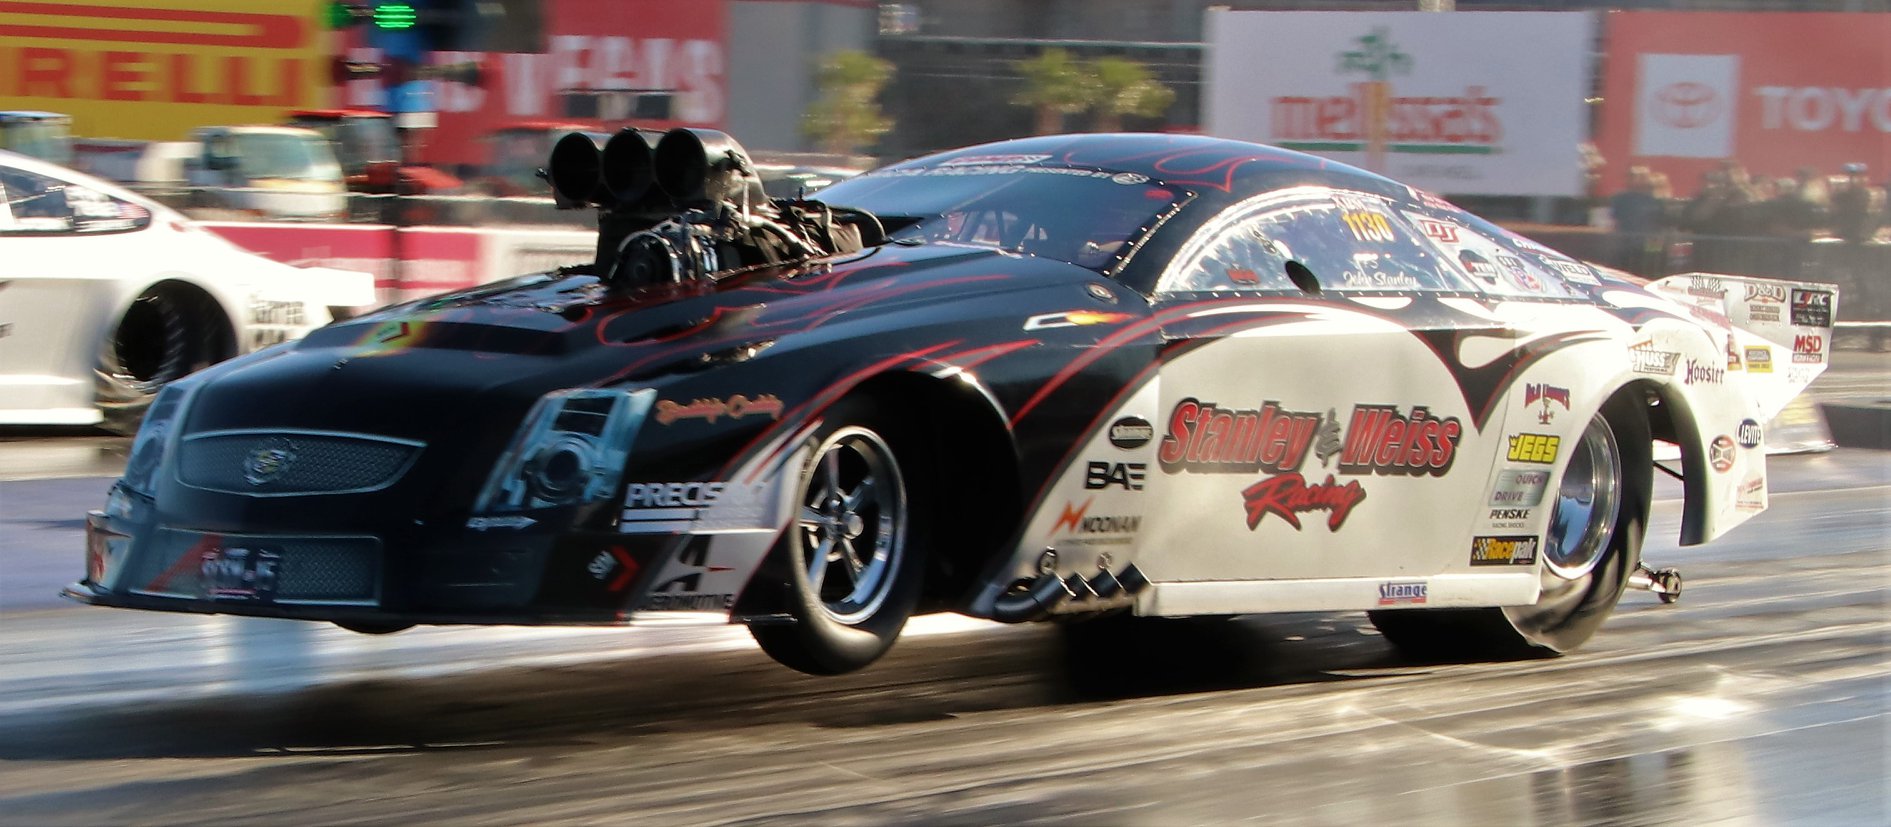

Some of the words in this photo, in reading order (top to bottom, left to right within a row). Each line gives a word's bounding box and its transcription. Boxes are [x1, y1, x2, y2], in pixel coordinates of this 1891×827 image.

[1342, 212, 1395, 242] 1130
[1794, 334, 1822, 353] MSD
[1684, 357, 1725, 386] Hoosier
[1159, 397, 1324, 475] Stanley
[1338, 403, 1465, 478] Weiss
[1507, 433, 1561, 464] JEGS
[1084, 460, 1148, 491] BAE
[1515, 474, 1543, 486] QUICK
[1241, 473, 1367, 532] Racing
[1494, 490, 1524, 502] DRIVE
[1489, 508, 1531, 520] PENSKE
[1484, 538, 1537, 565] Racepak
[1379, 582, 1428, 601] Strange
